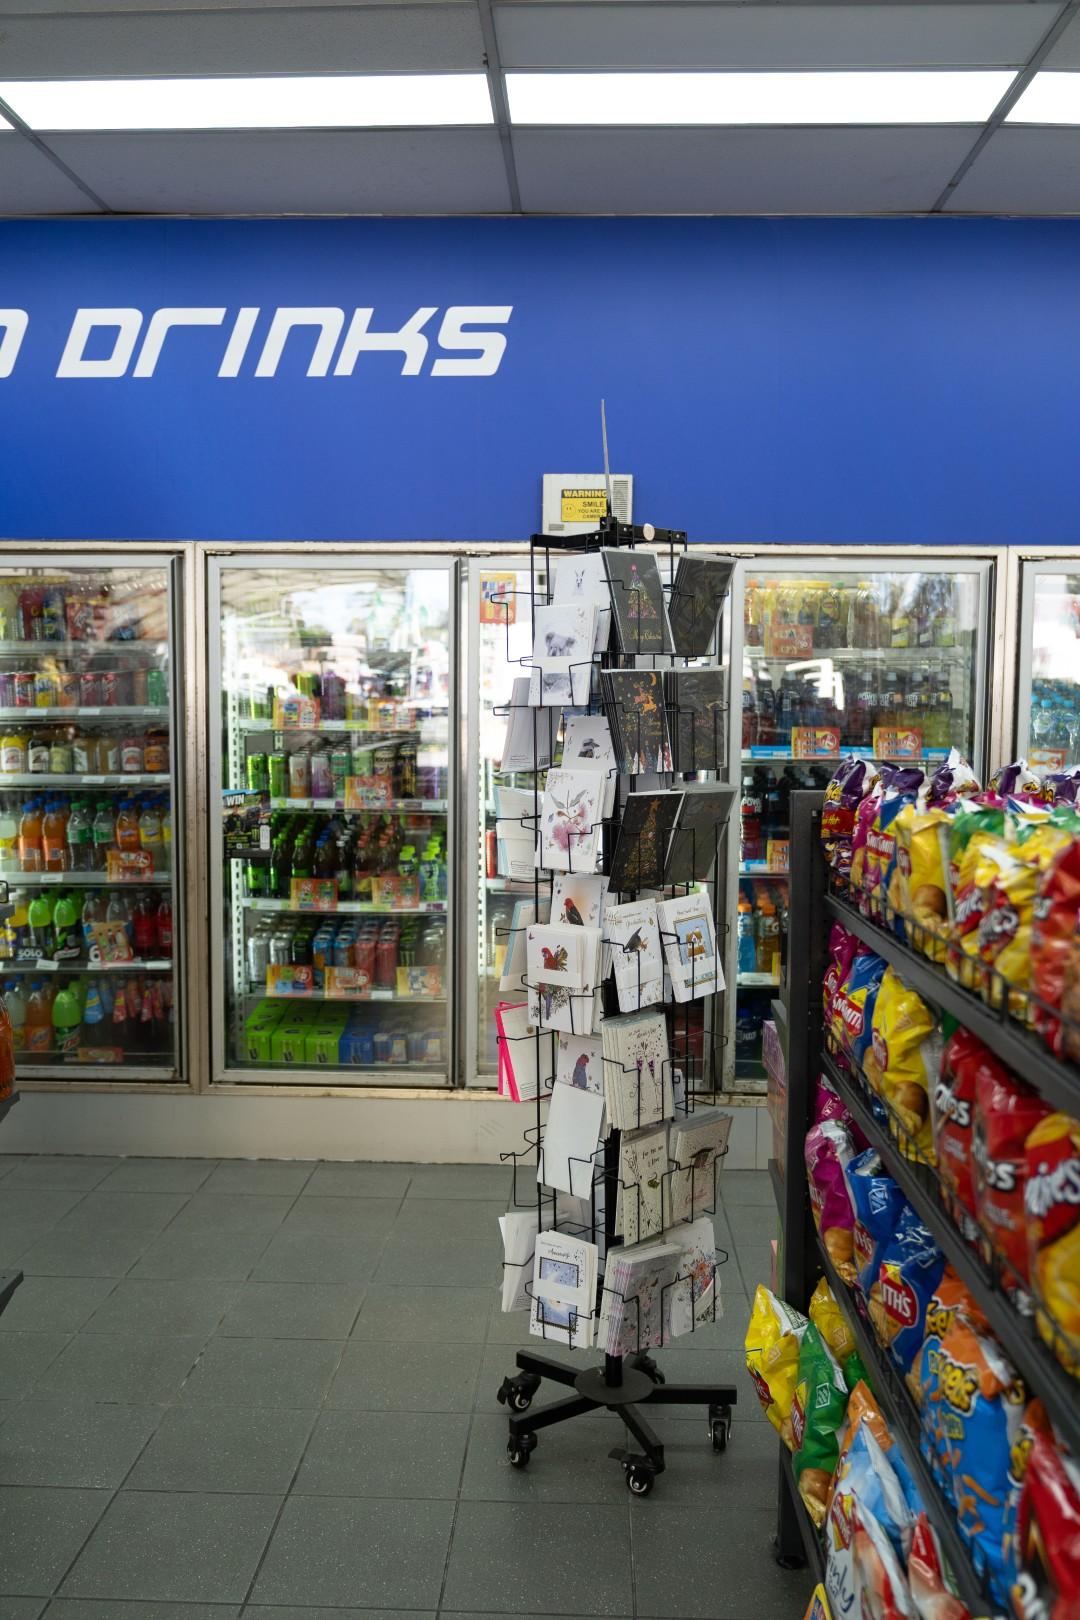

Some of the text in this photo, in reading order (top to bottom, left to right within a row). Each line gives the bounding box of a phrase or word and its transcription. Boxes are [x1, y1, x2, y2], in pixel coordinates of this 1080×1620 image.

[55, 305, 514, 378] DRINKS
[226, 794, 245, 806] WIN
[18, 949, 43, 958] SOLO
